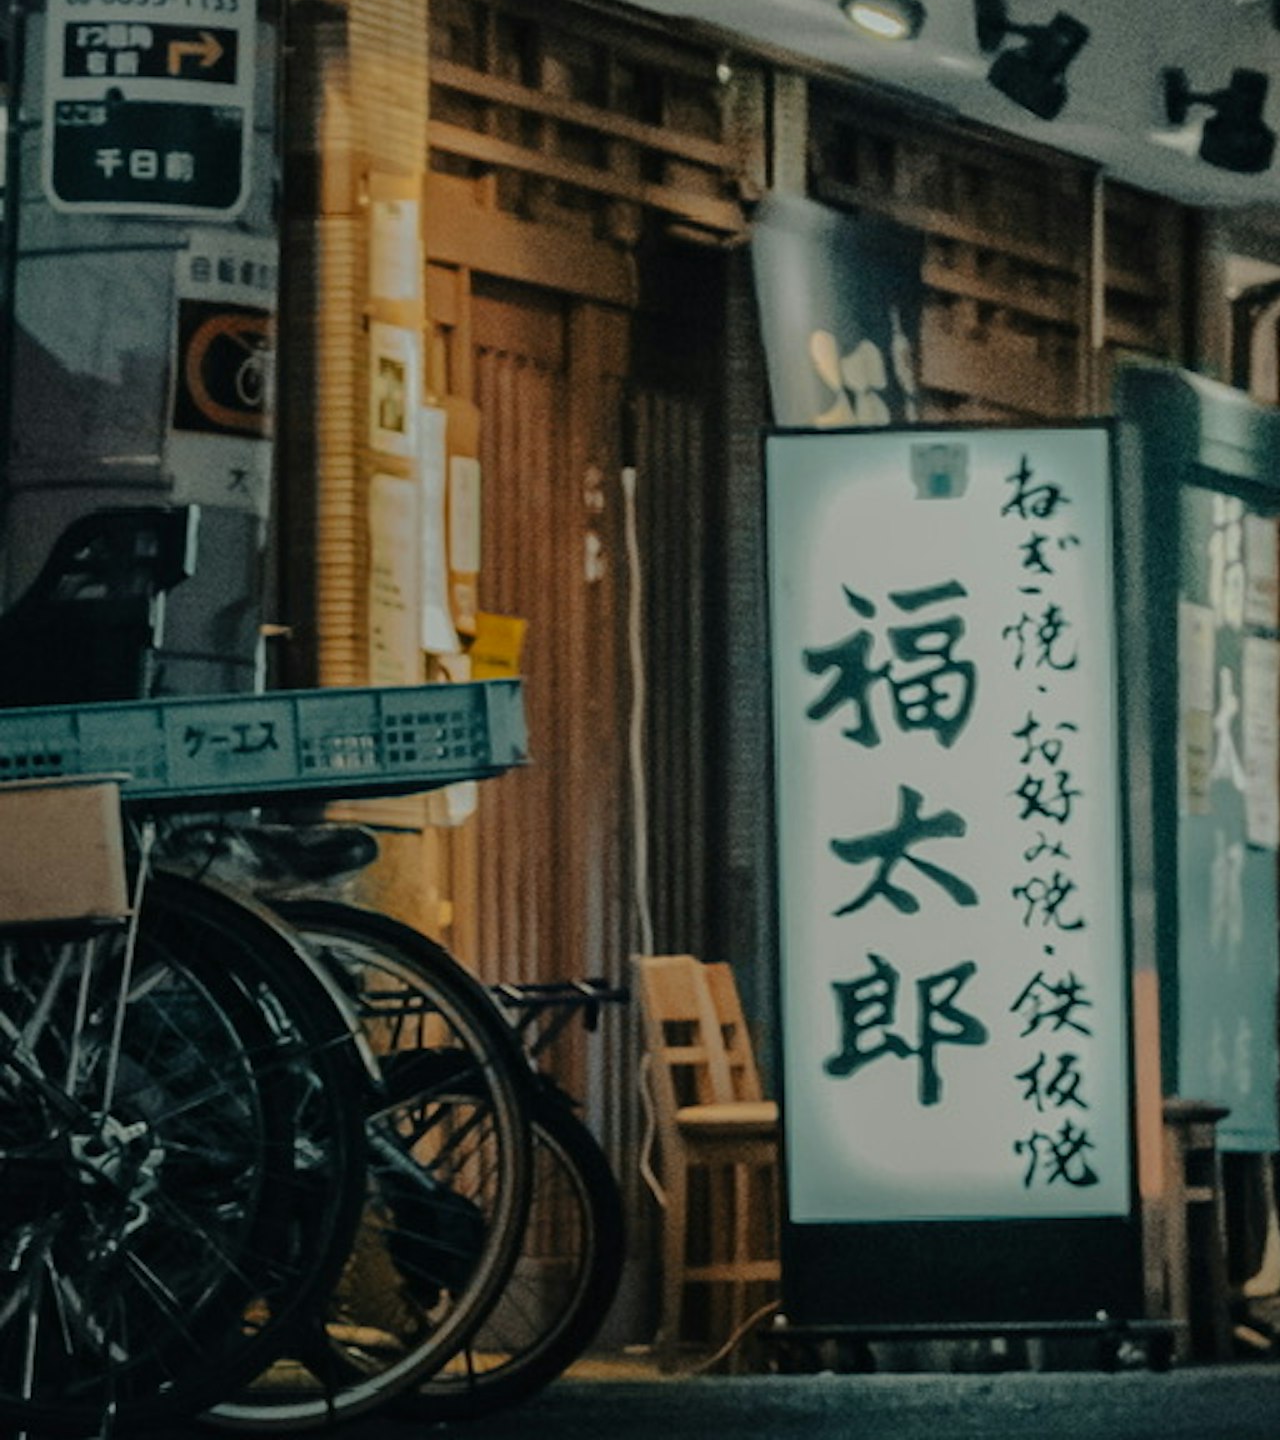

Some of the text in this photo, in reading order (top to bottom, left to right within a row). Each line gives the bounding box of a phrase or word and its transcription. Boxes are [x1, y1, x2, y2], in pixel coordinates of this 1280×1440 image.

[95, 148, 195, 183] 千日前
[184, 720, 280, 759] ケーエス
[802, 580, 990, 1107] 福太郎
